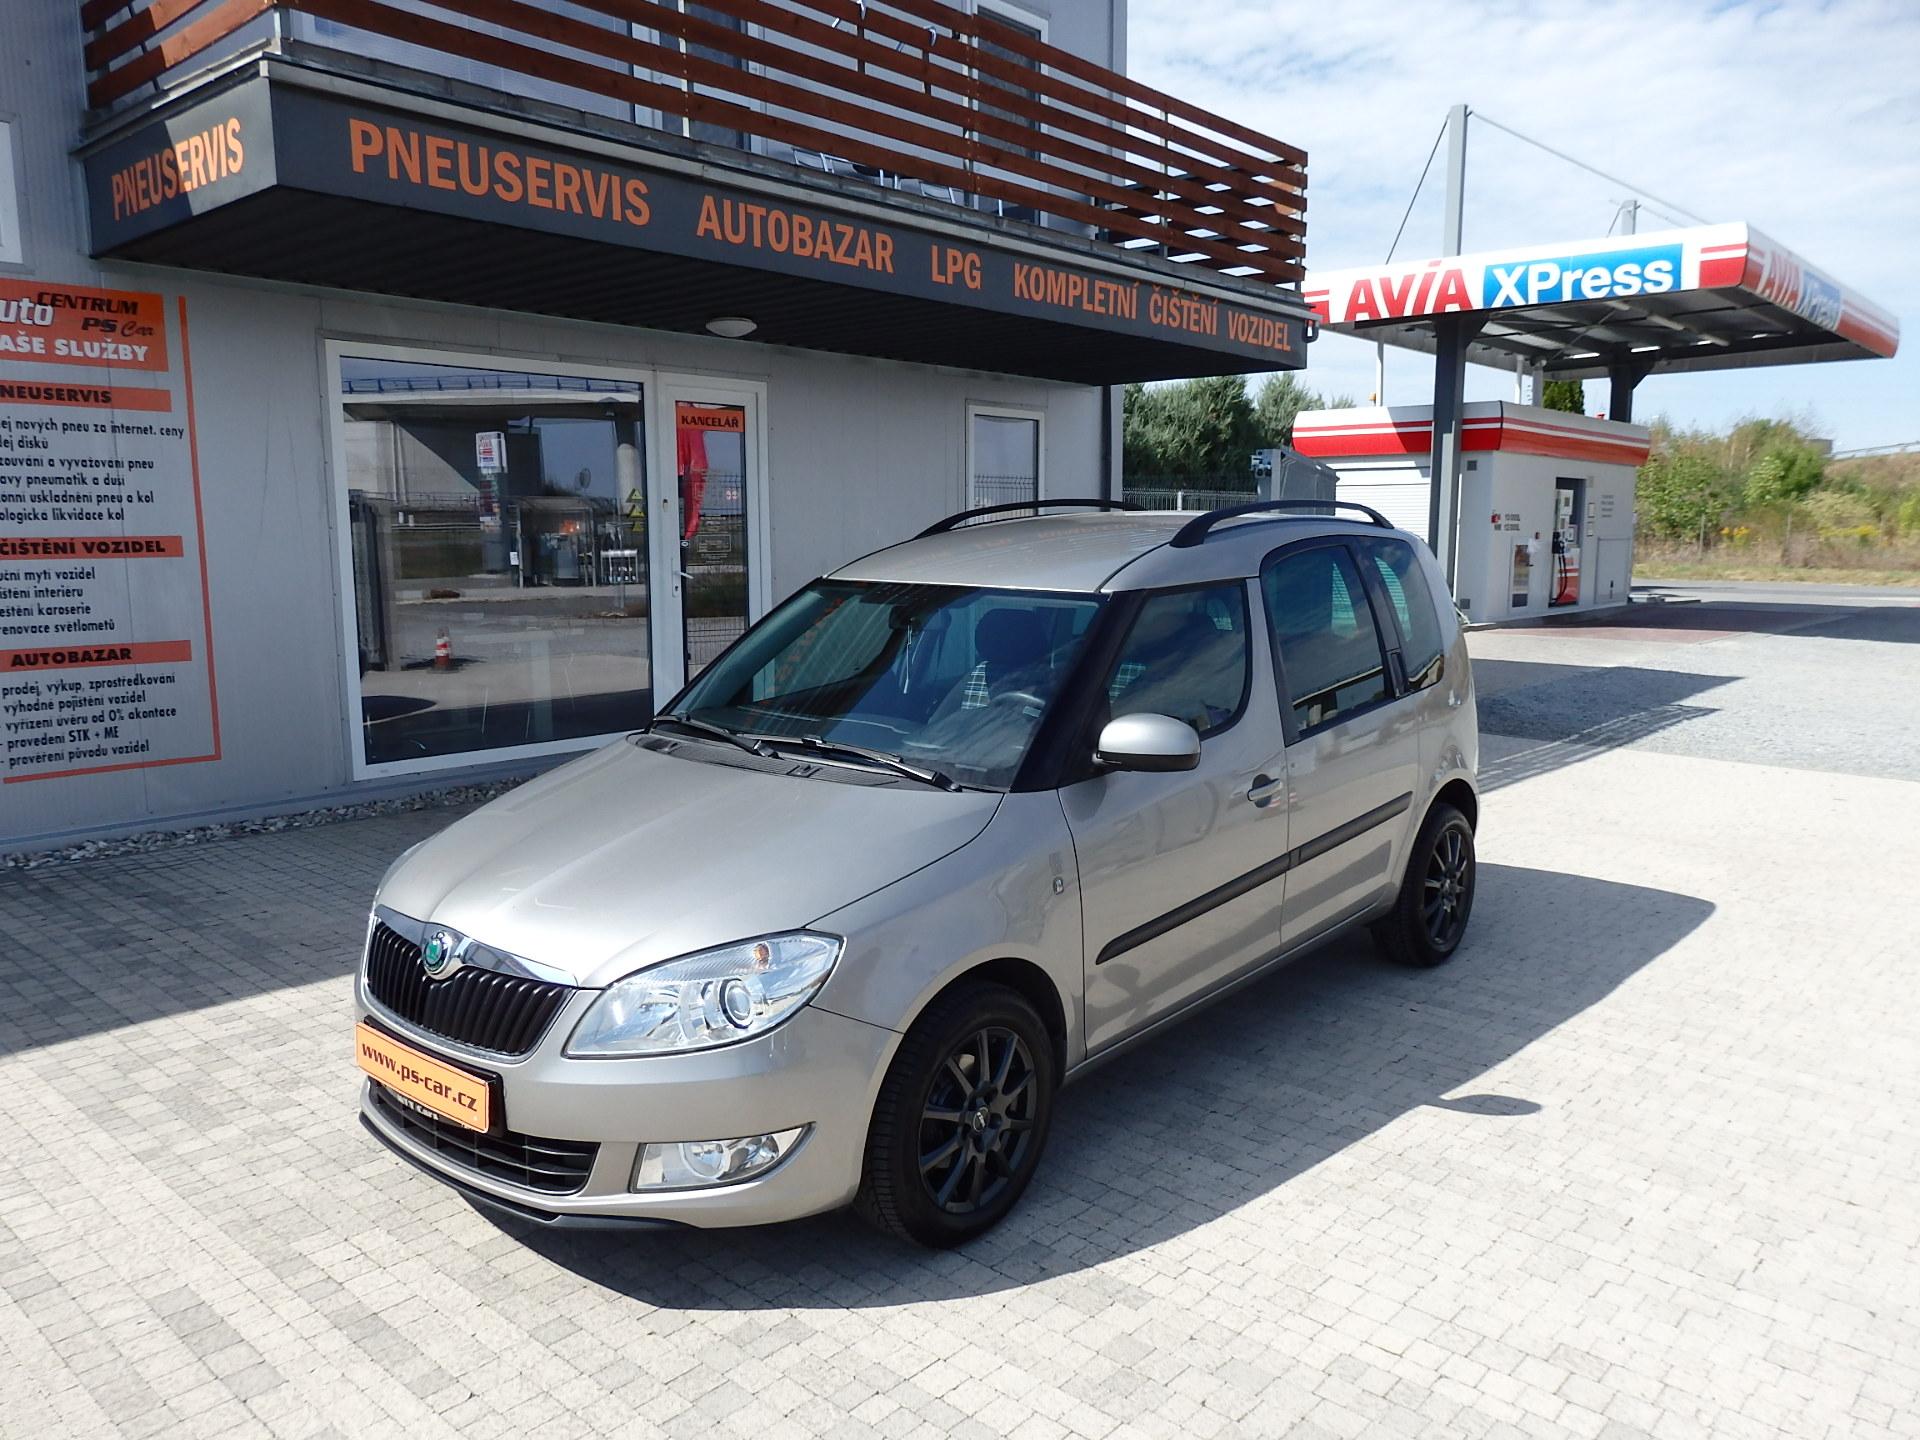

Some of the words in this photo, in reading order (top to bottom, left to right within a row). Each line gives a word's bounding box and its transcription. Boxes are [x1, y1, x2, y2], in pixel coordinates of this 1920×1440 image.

[112, 117, 244, 221] PNEUSERVIS
[349, 117, 651, 226] PNEUSERVIS
[696, 194, 894, 274] AUTOBAZAR
[931, 245, 982, 290] LPG
[1013, 262, 1141, 320] KOMPLETNÍ
[1149, 284, 1219, 336] ČIŠTĚNÍ
[1228, 310, 1291, 351] VOZIDEL
[1490, 259, 1675, 308] XPress
[37, 292, 138, 315] CENTRUM
[82, 317, 117, 333] PS
[55, 337, 148, 362] SLUŽBY
[62, 422, 90, 435] pneu
[93, 423, 107, 433] za
[110, 420, 157, 436] internet.
[159, 427, 184, 439] ceny
[0, 435, 14, 452] ej
[48, 458, 55, 467] a
[128, 459, 154, 472] pneu
[27, 472, 88, 488] pneumatik
[92, 476, 100, 486] a
[96, 494, 123, 506] pneu
[127, 494, 133, 503] a
[137, 489, 154, 503] kol
[52, 507, 103, 521] likvidace
[107, 507, 125, 521] kol
[0, 537, 76, 555] ČIŠTĚNÍ
[82, 540, 165, 554] VOZIDEL
[55, 566, 96, 580] vozidel
[37, 602, 91, 616] karoserie
[11, 647, 132, 667] AUTOBAZAR
[108, 690, 146, 705] vozidel
[92, 709, 105, 723] od
[109, 708, 125, 722] 0%
[128, 707, 176, 720] akontace
[68, 729, 91, 743] STK
[104, 725, 119, 739] ME
[111, 739, 149, 755] vozidel
[362, 1042, 478, 1112] www.ps-car.cz
